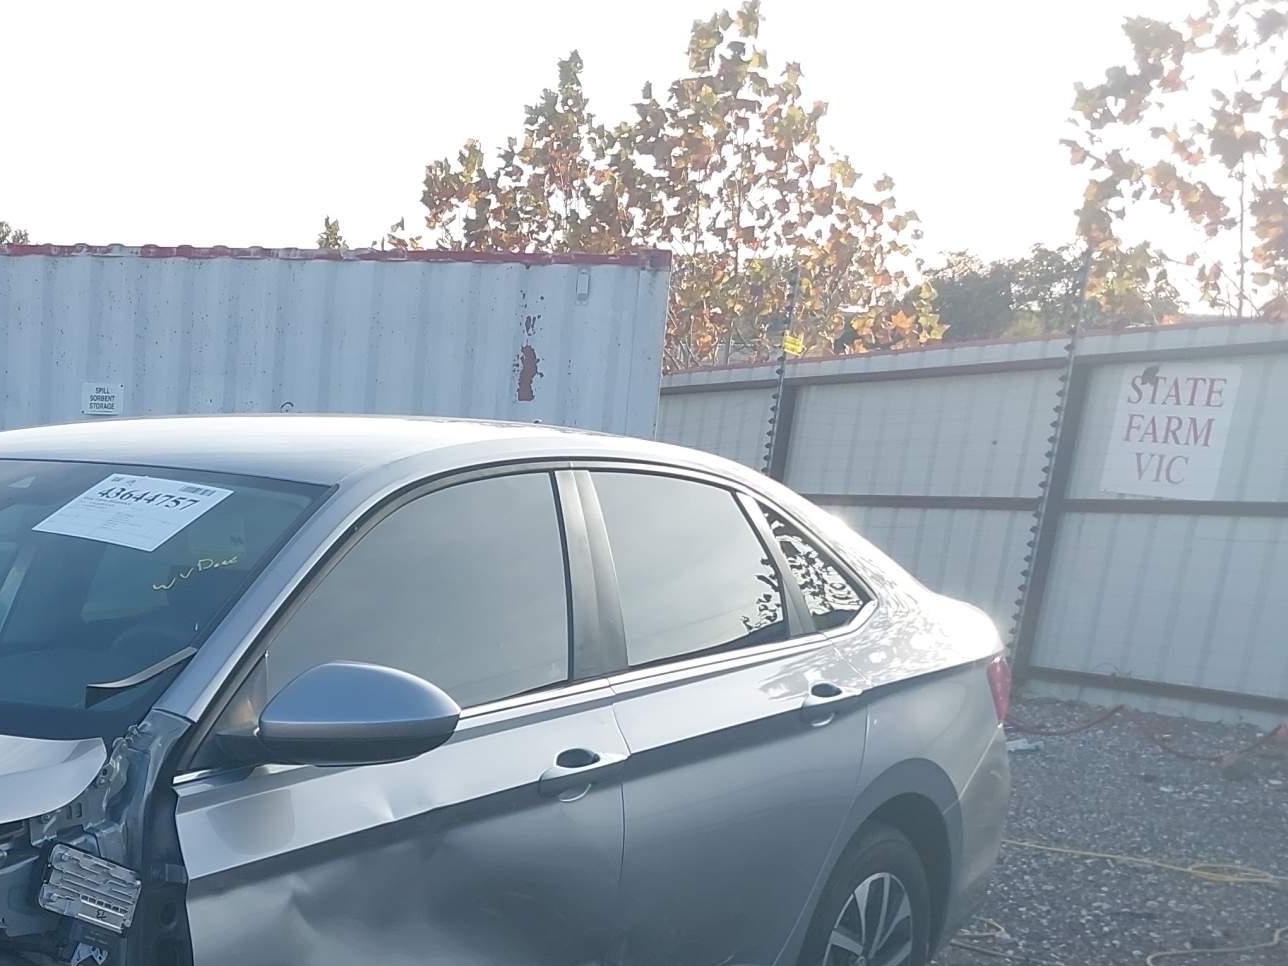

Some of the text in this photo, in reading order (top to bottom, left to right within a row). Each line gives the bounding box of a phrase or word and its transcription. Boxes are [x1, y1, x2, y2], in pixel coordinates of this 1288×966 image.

[1127, 374, 1227, 408] STATE
[1123, 413, 1216, 447] FARM
[1135, 452, 1189, 485] VIC
[98, 486, 200, 511] 43644757
